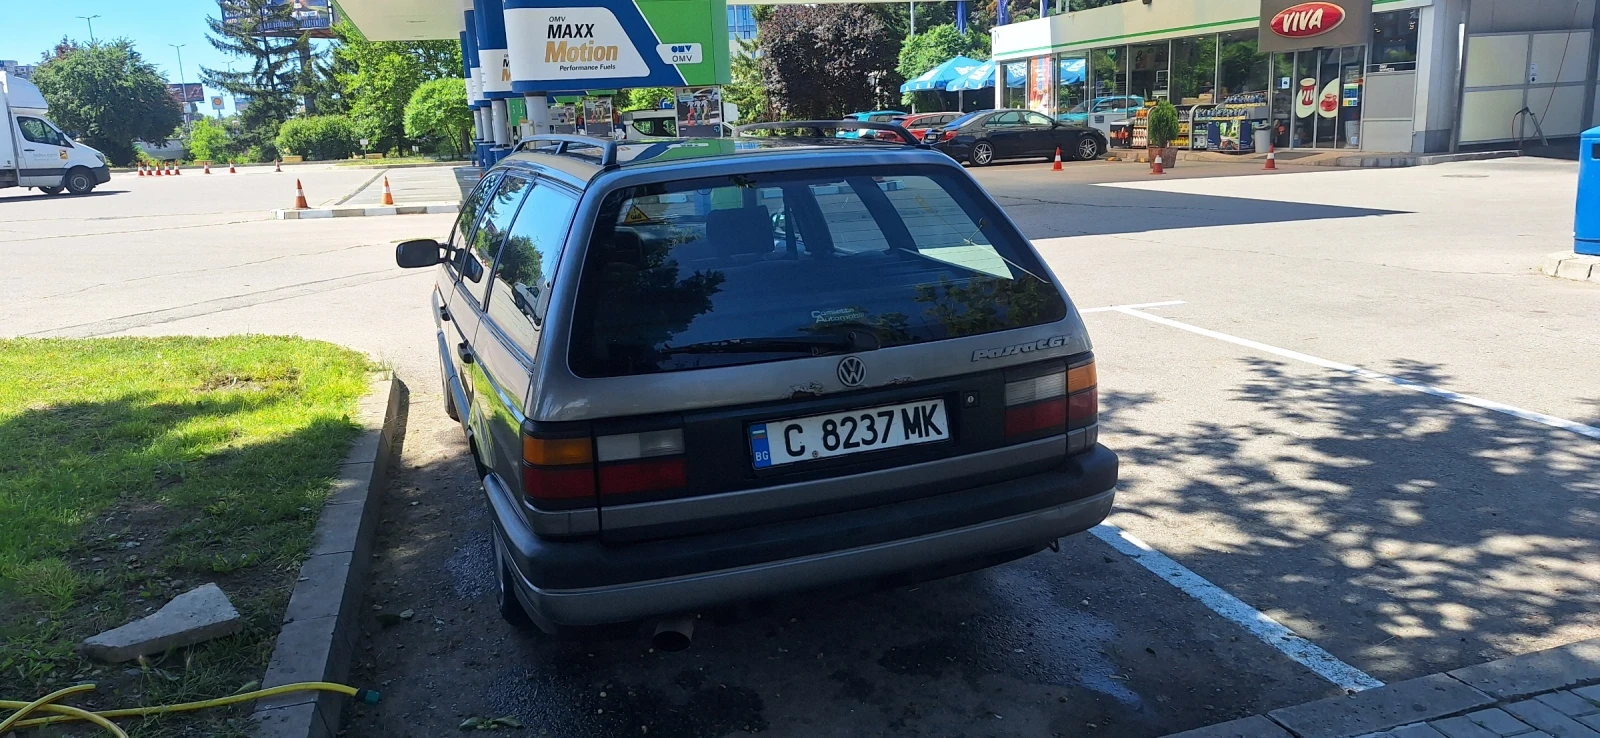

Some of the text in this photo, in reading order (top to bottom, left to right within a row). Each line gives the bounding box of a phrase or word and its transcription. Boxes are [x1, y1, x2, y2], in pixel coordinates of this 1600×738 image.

[1282, 8, 1324, 33] VIVA
[547, 23, 595, 39] MAXX
[545, 40, 618, 63] Motion
[672, 55, 693, 63] OMV
[784, 403, 943, 457] C 8237 MK
[755, 450, 769, 462] BG
